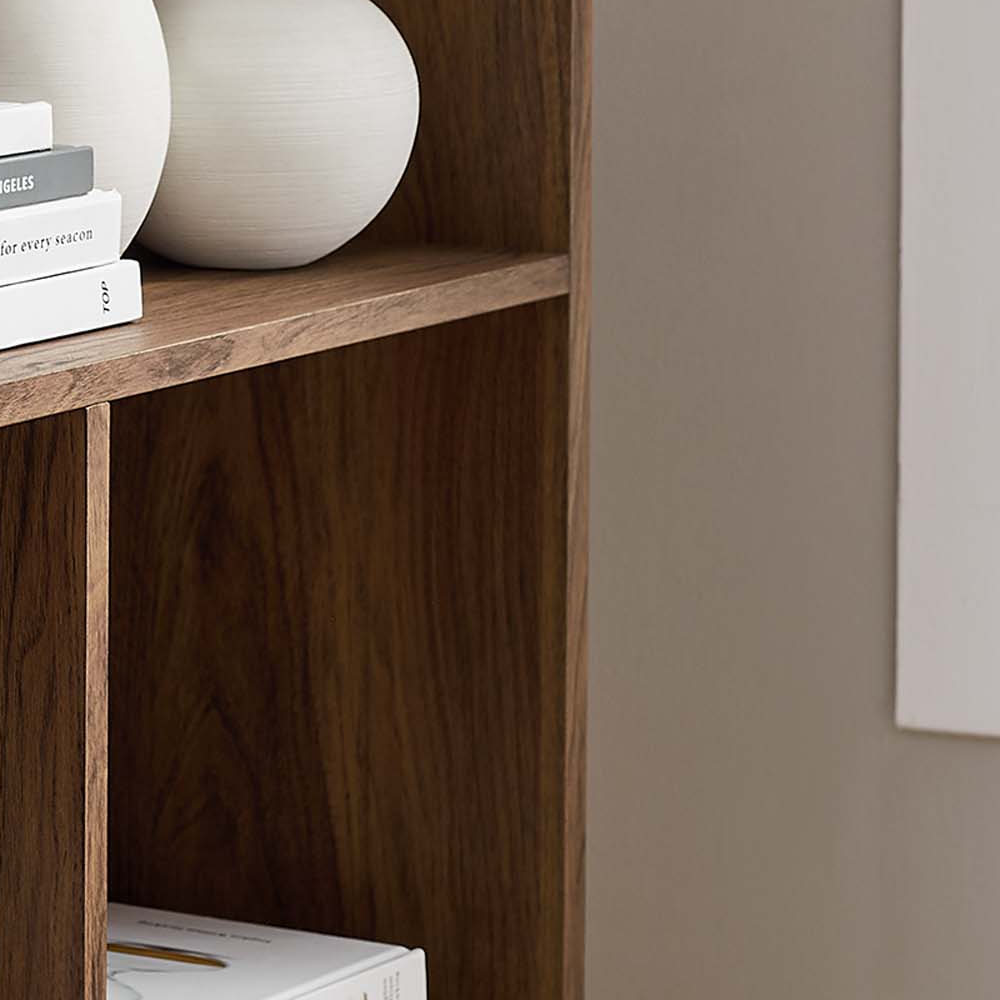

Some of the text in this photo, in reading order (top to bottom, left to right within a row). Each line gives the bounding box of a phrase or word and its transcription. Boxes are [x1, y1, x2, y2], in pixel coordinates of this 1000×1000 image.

[0, 240, 18, 257] for
[20, 236, 51, 253] every
[101, 280, 111, 314] TOP
